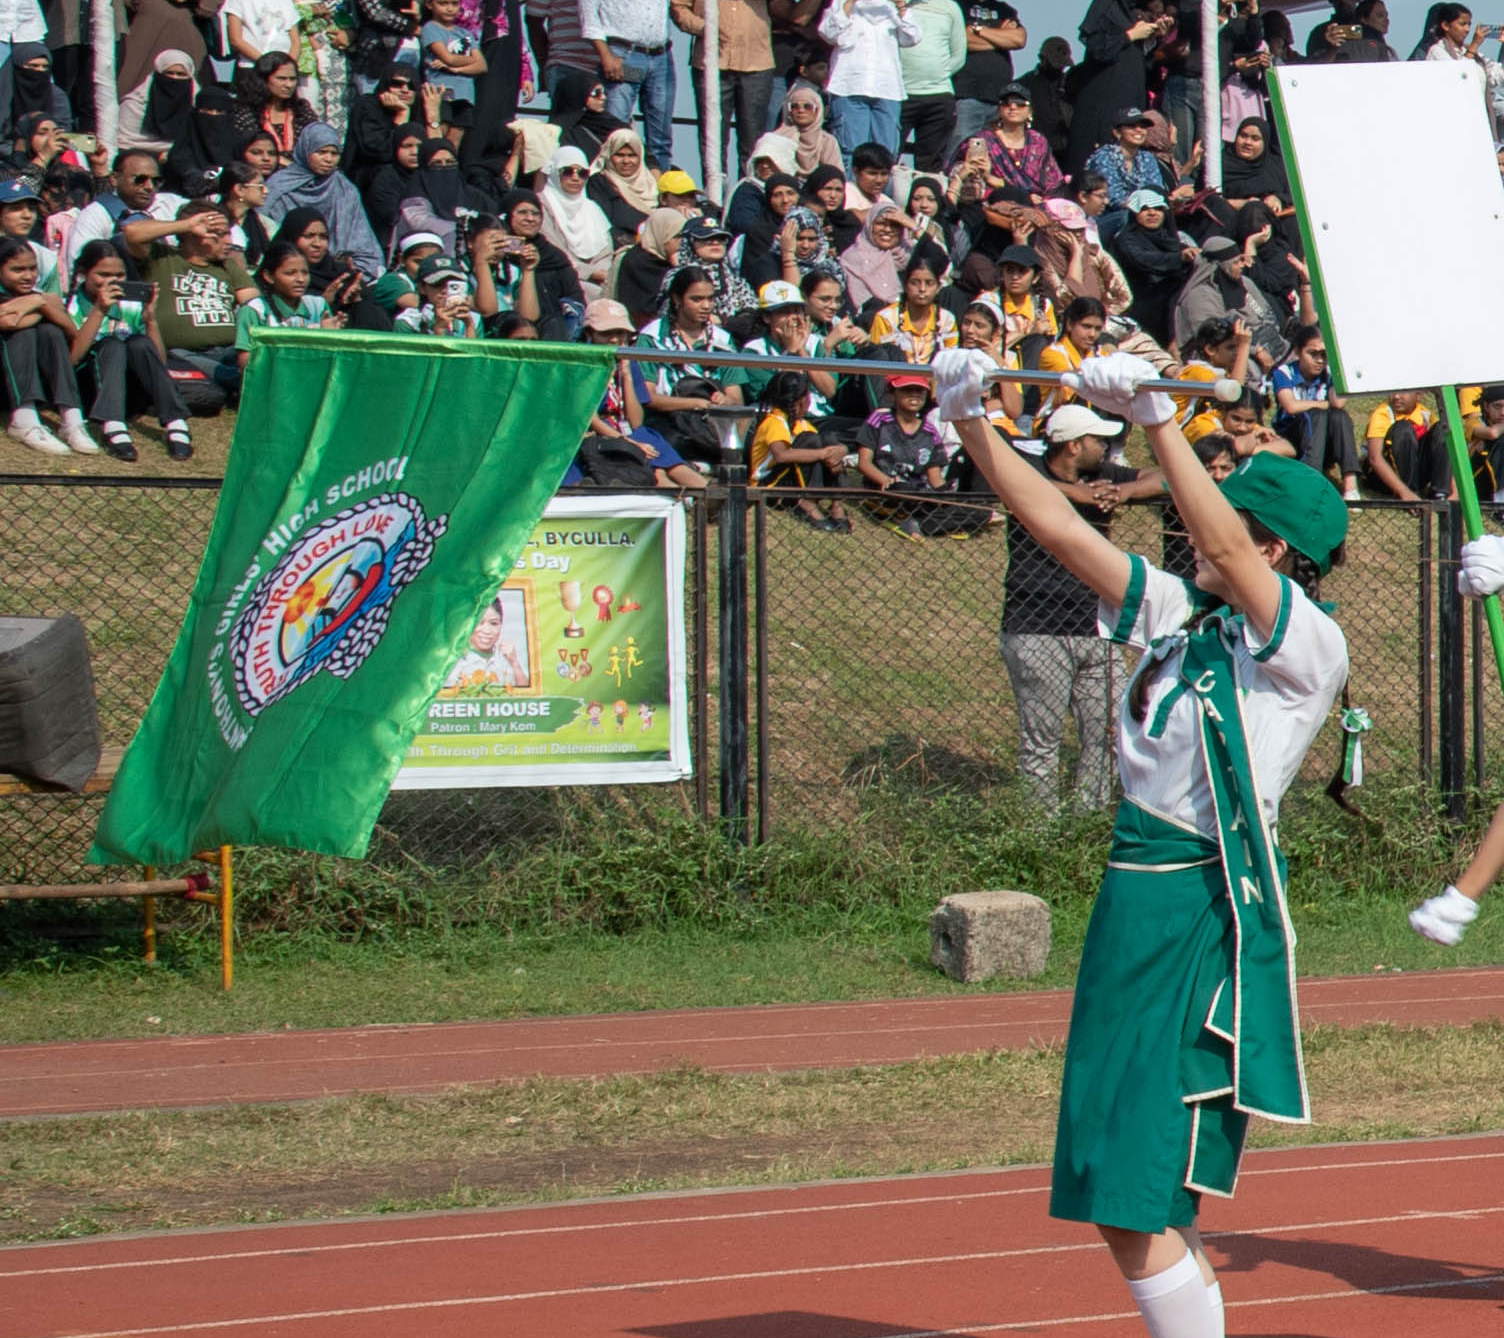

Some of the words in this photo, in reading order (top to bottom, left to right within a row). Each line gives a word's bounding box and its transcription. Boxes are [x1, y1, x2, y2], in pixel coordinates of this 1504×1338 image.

[262, 499, 320, 556] HIGH
[545, 532, 637, 546] BYCULLA.
[532, 551, 571, 573] Day
[256, 529, 346, 637] THROUGH
[429, 703, 481, 718] REEN
[486, 701, 551, 717] HOUSE
[430, 722, 470, 733] Patron
[479, 721, 507, 734] Mary
[510, 721, 537, 732] Kom
[429, 744, 489, 760] Through
[1194, 670, 1264, 905] CATAIN
